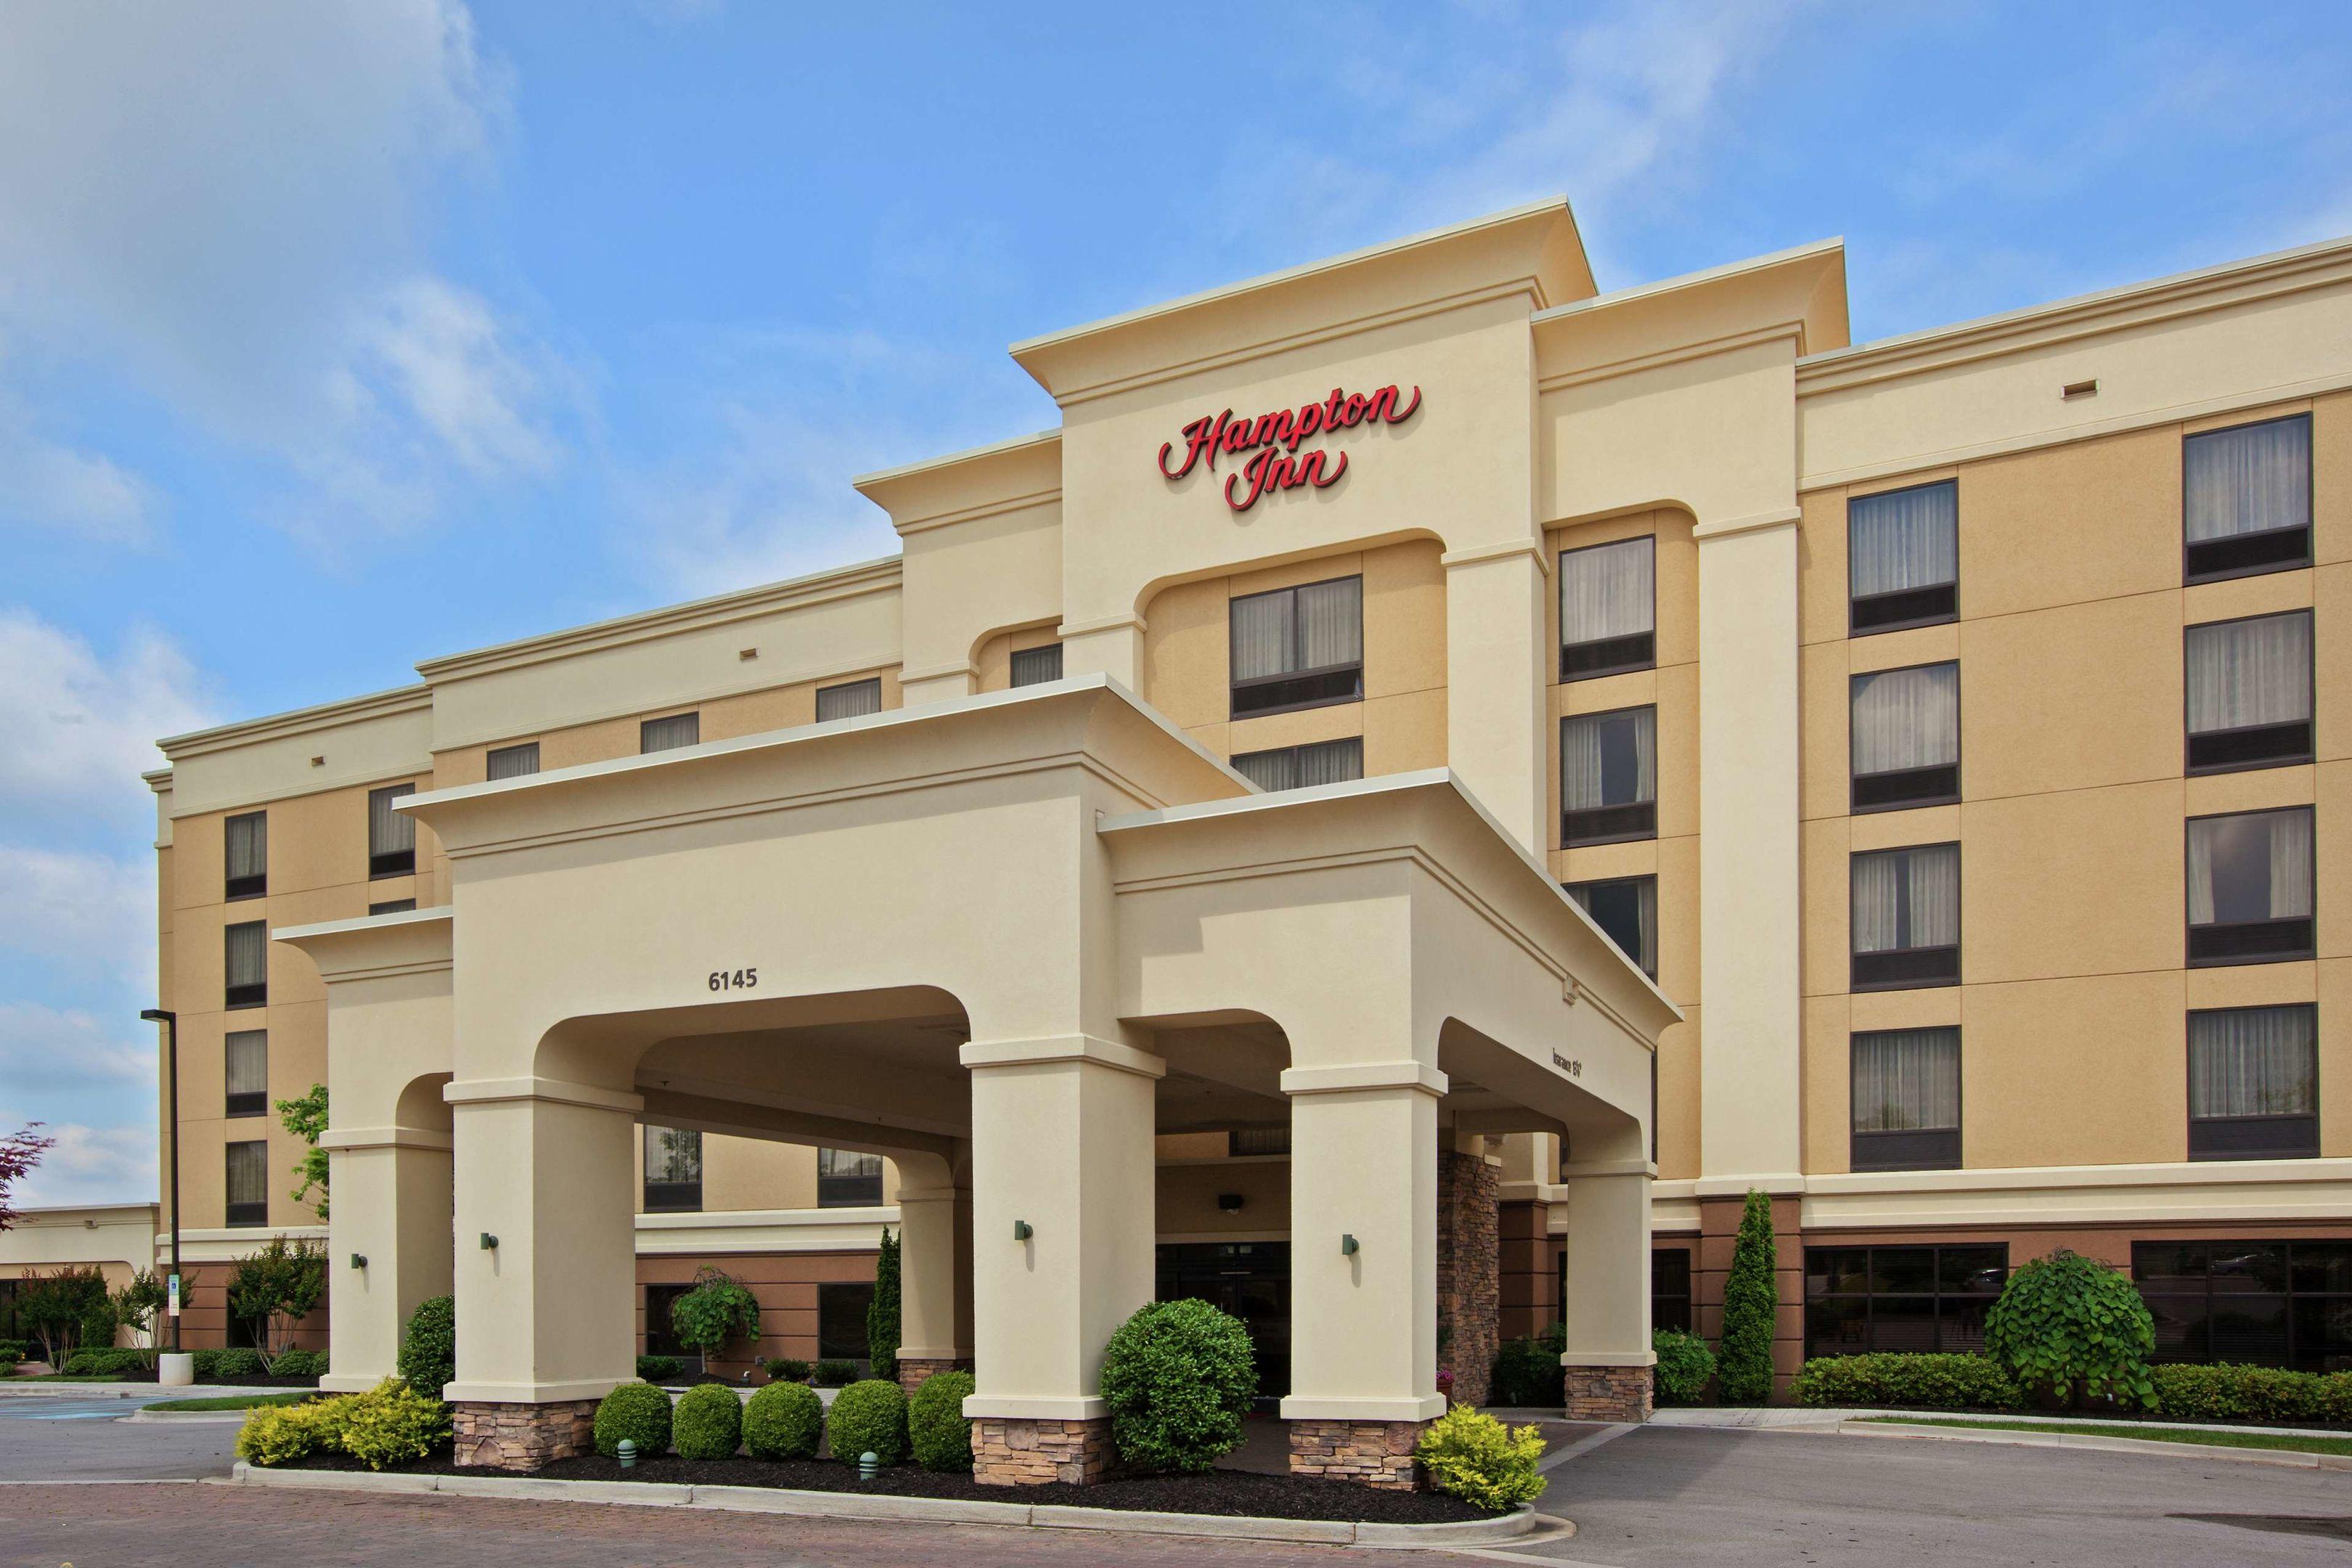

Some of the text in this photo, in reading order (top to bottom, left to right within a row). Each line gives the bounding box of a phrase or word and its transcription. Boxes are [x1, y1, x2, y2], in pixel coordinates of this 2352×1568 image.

[1159, 384, 1421, 480] Hampton
[1225, 446, 1348, 511] Inn
[709, 968, 757, 992] 6145
